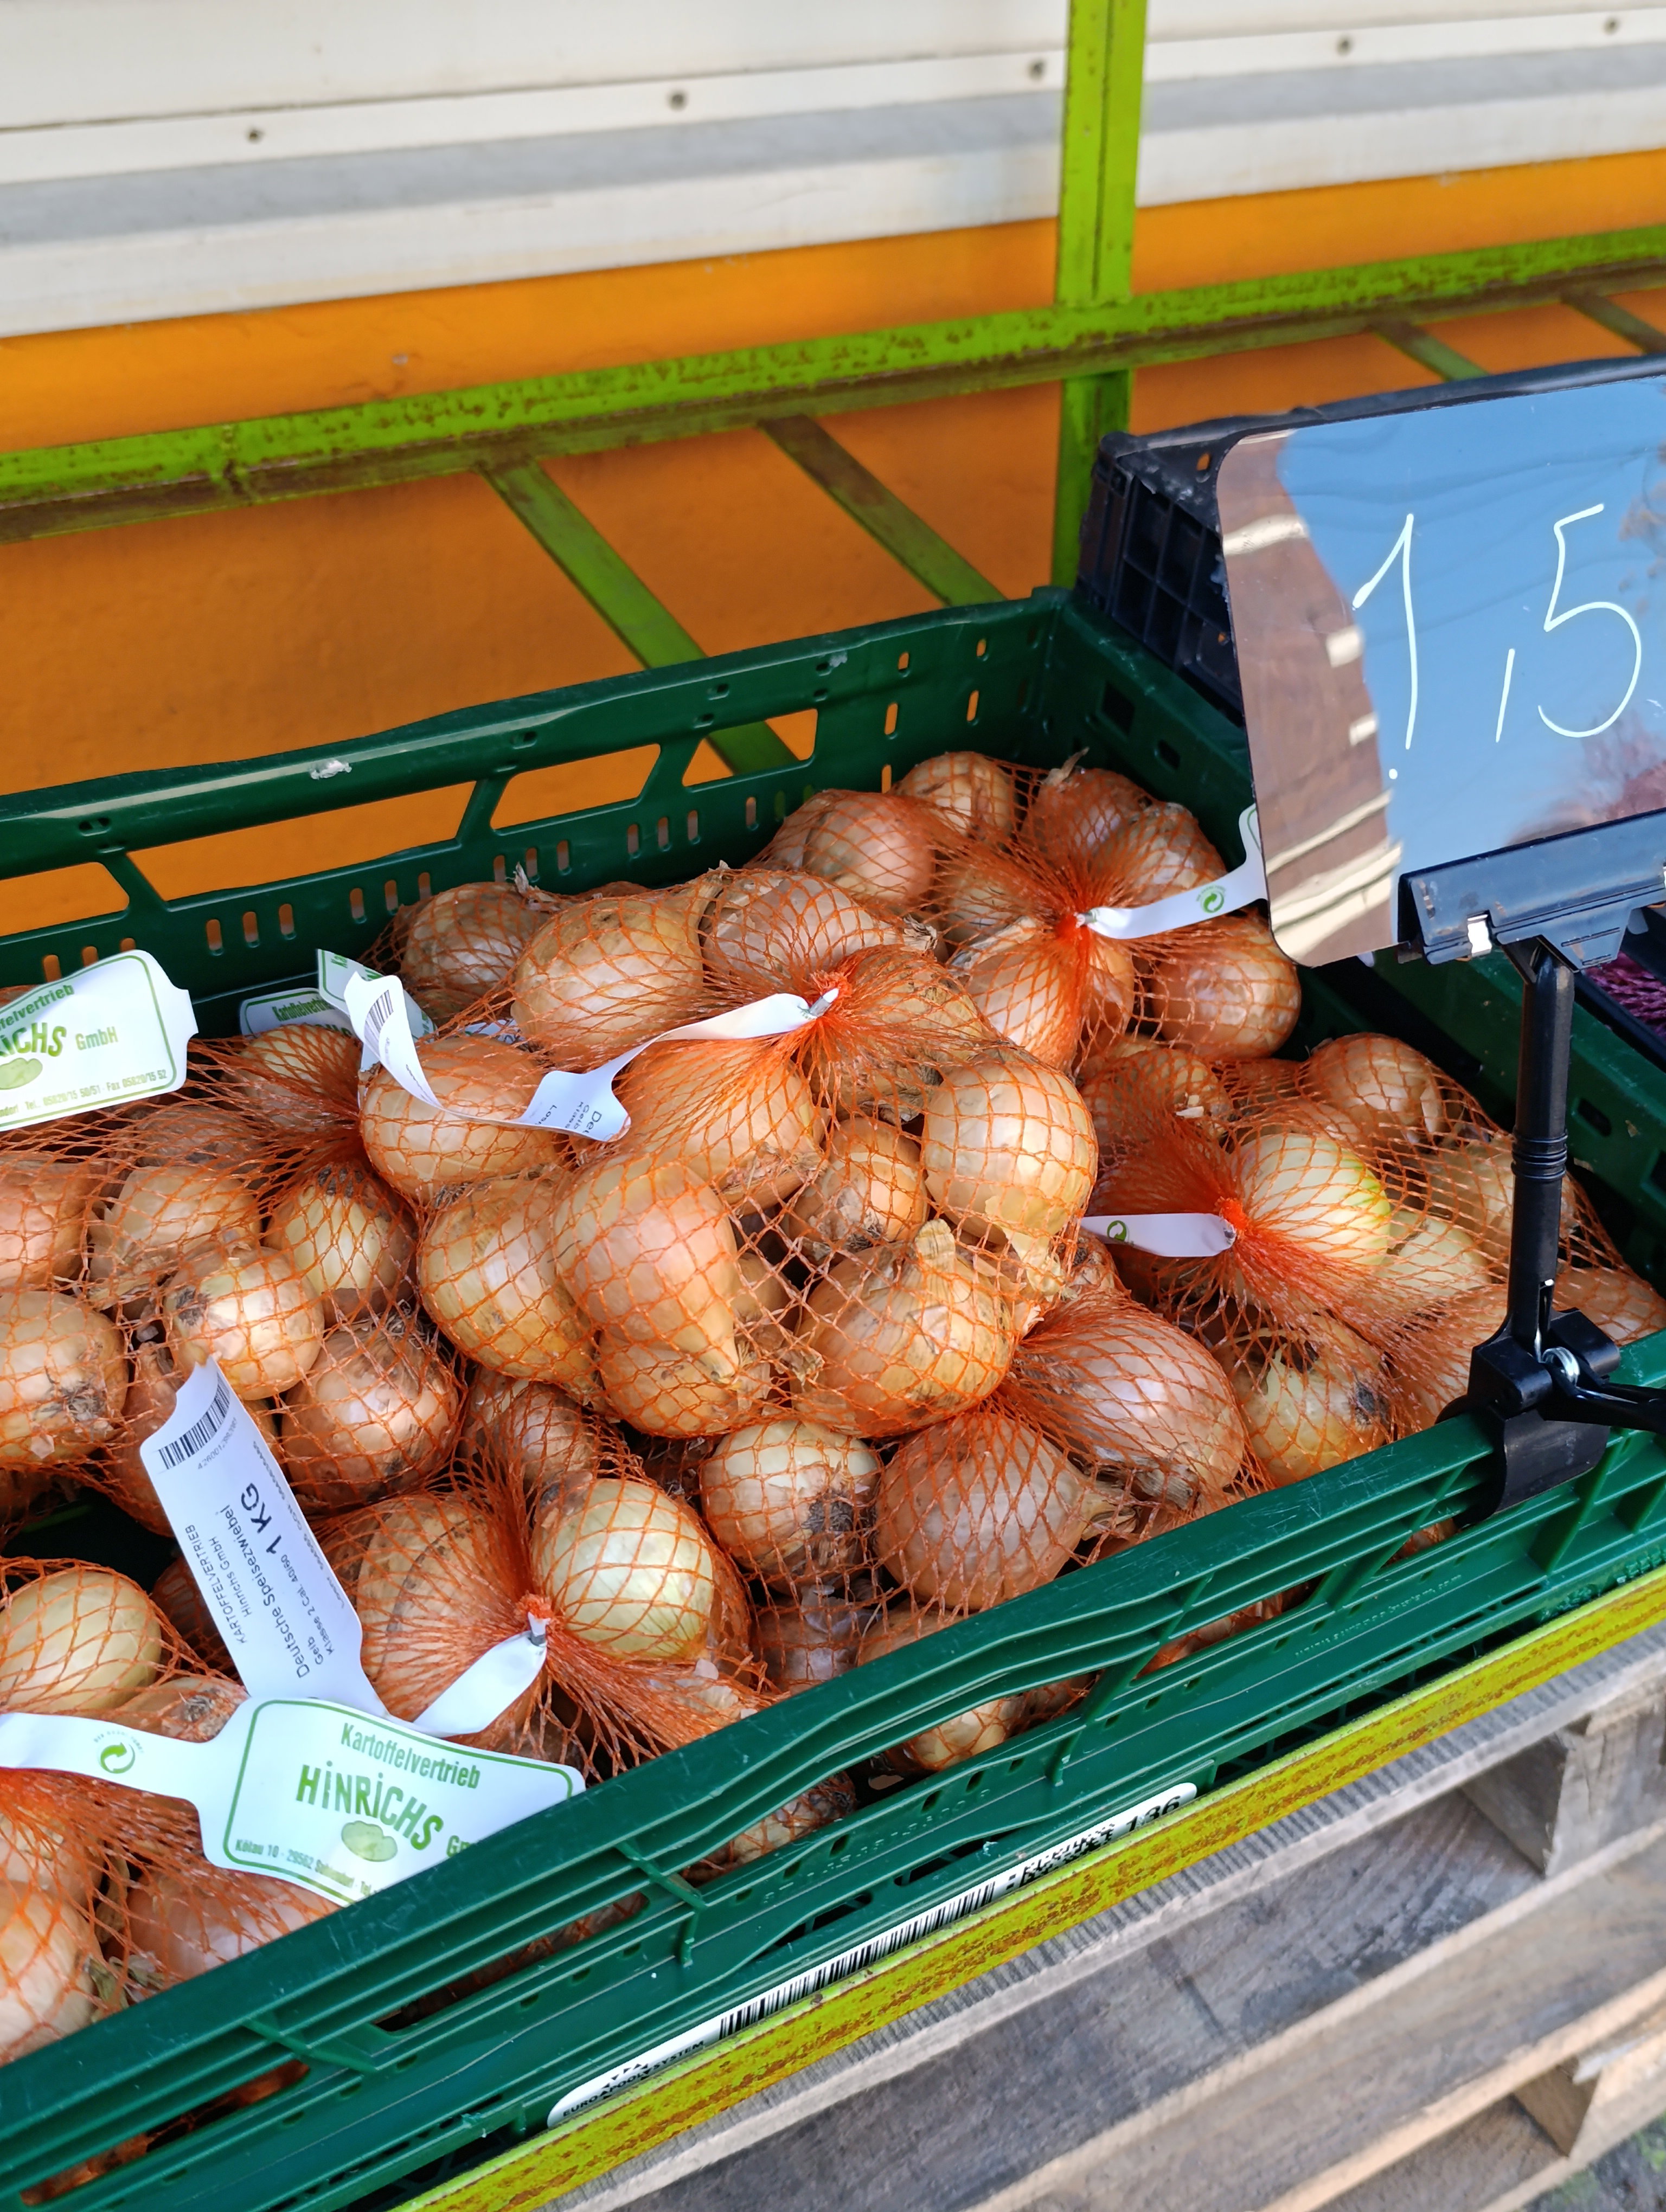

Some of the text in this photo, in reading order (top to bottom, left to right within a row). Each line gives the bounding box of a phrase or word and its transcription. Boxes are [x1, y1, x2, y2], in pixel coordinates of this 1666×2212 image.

[0, 1023, 119, 1057] iCHS GmbH
[241, 1482, 272, 1534] KG
[220, 1504, 275, 1606] Speisezwiebel
[265, 1534, 282, 1554] 1
[185, 1524, 247, 1644] KARTOFFELVERTRIEB
[208, 1536, 253, 1618] Hinrichs GmbH
[307, 1606, 316, 1616] 2
[272, 1607, 310, 1678] Deutsche
[307, 1636, 324, 1665] Gelb
[313, 1616, 335, 1655] Klasse
[341, 1722, 481, 1789] Kartoffelvertrieb
[267, 1844, 279, 1858] 10
[652, 2040, 704, 2070] SYSTEM
